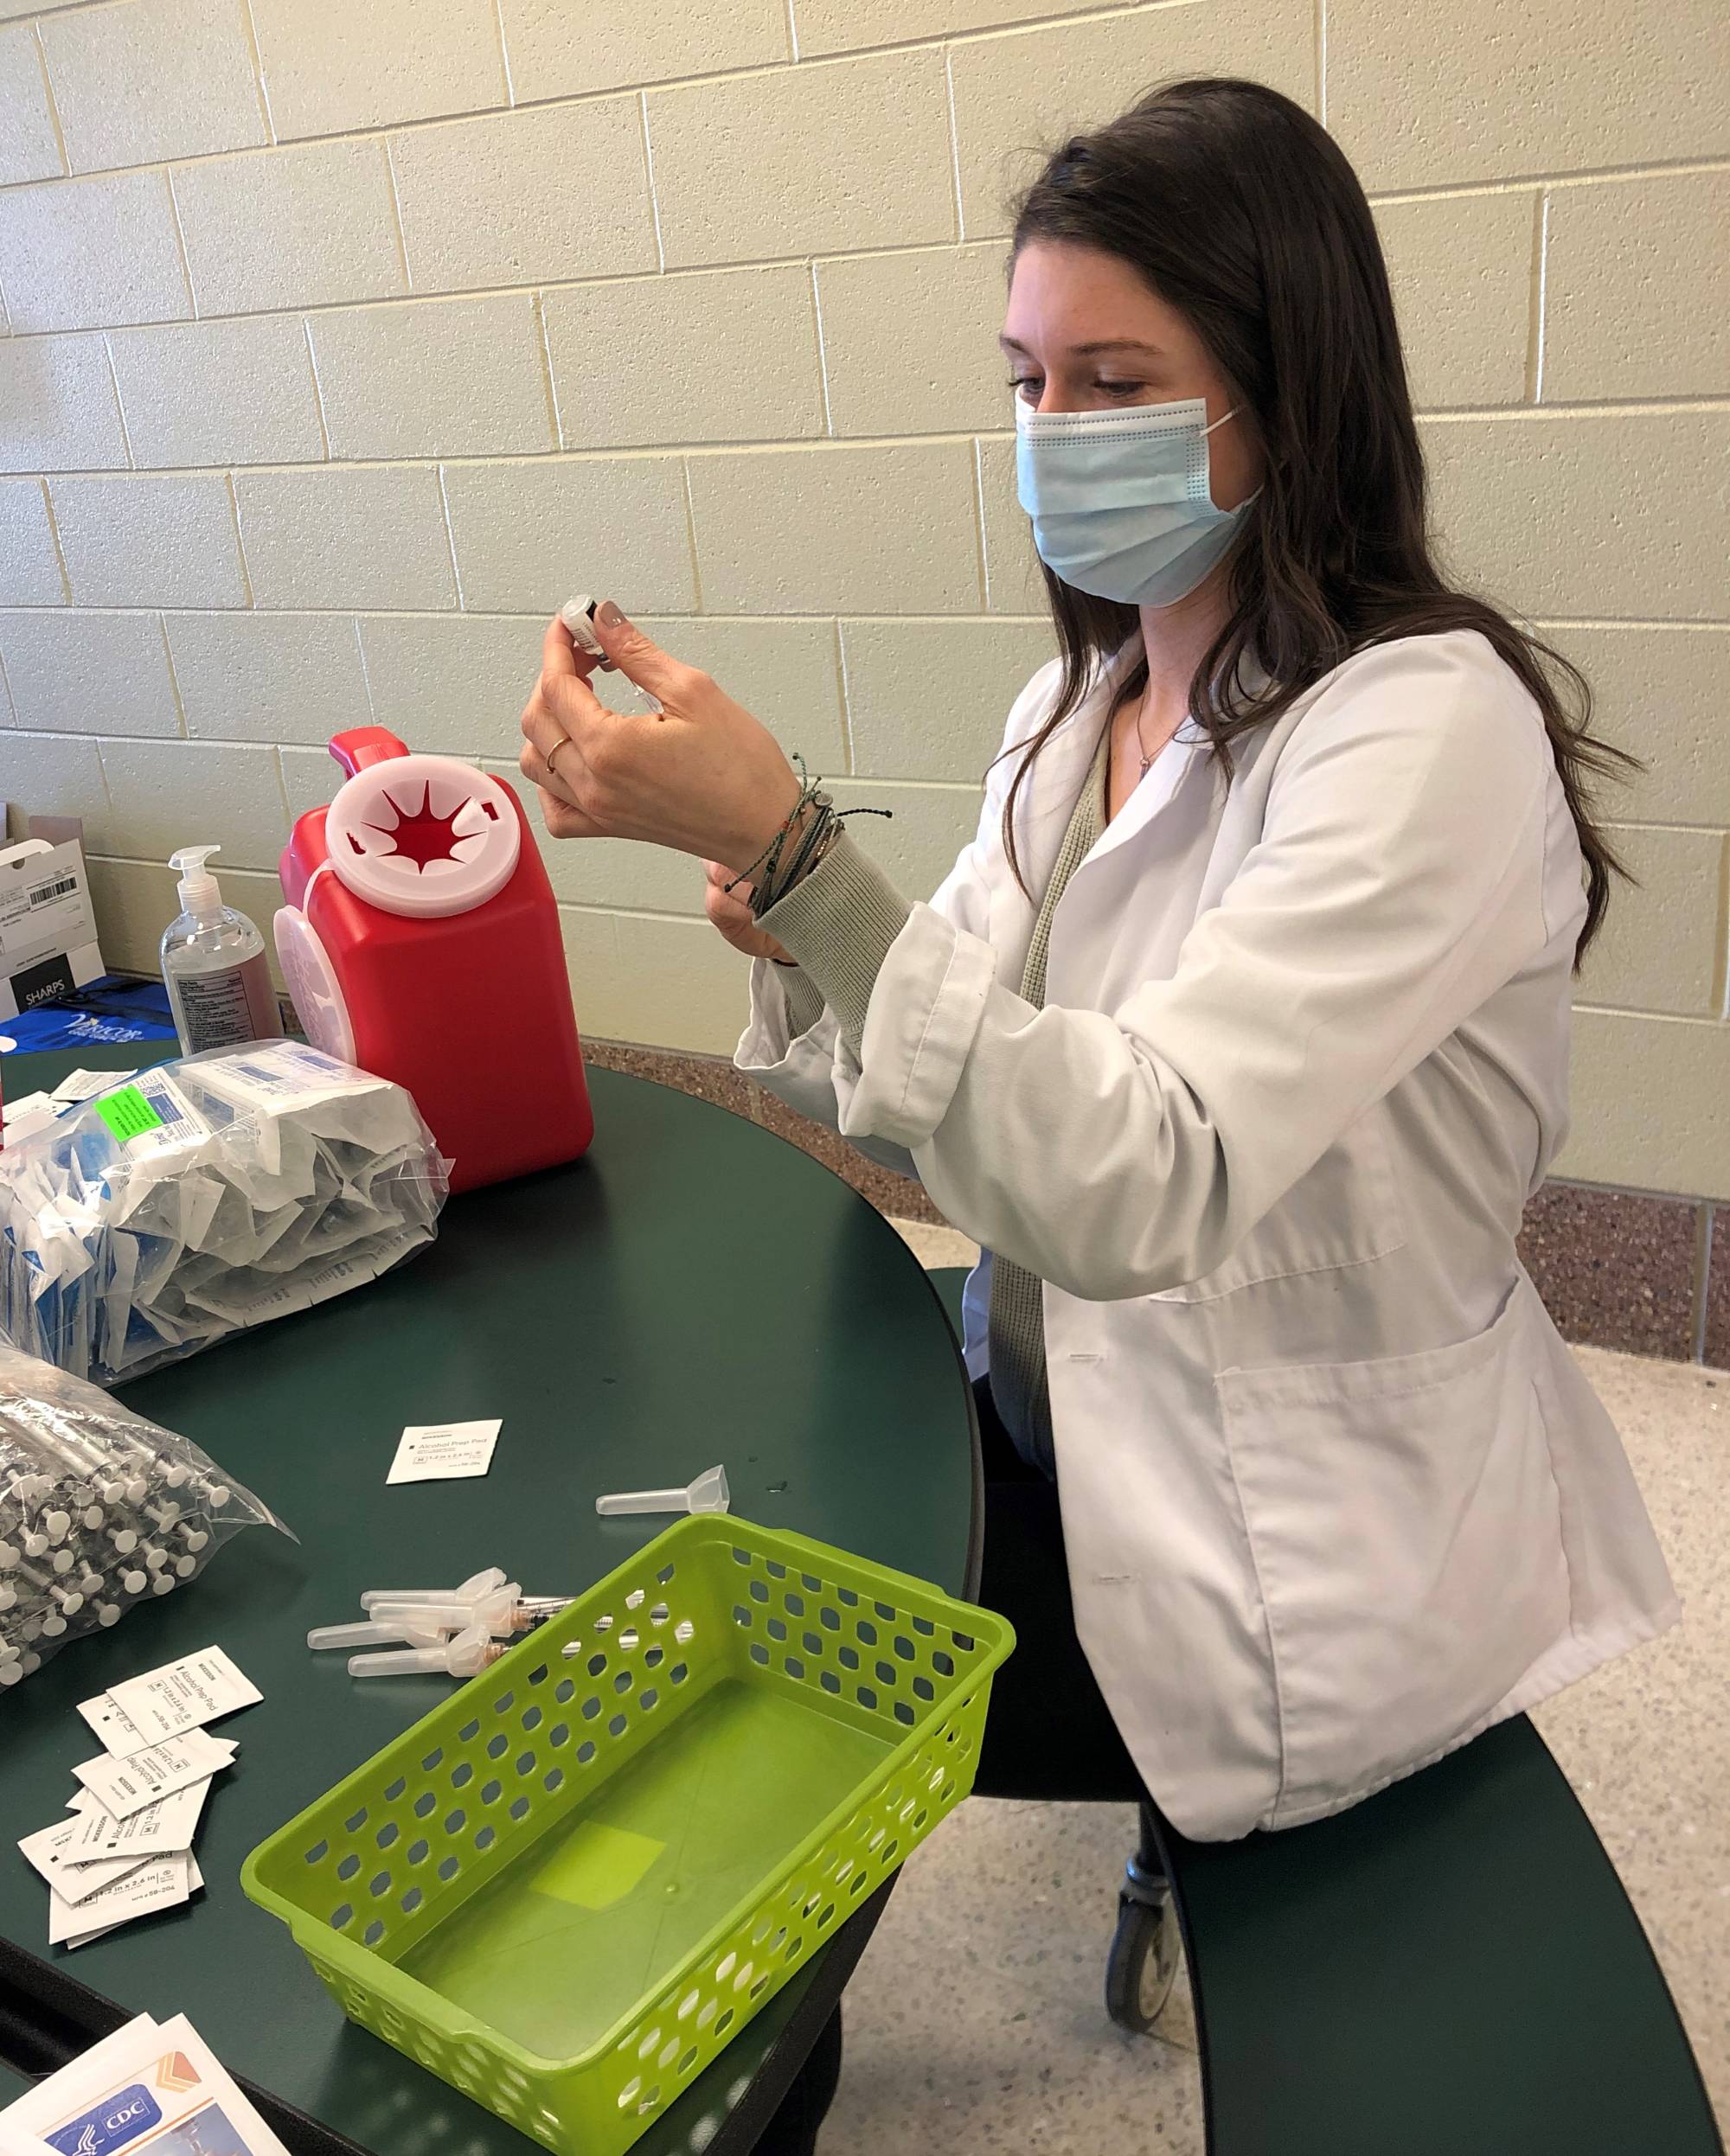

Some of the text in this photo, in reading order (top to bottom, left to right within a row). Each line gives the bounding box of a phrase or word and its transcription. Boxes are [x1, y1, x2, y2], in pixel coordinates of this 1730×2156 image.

[26, 979, 66, 1005] SHARPS
[180, 1670, 201, 1689] Alcohol
[195, 1686, 208, 1699] Prep
[204, 1697, 219, 1711] Pad
[126, 1756, 140, 1769] Prep
[134, 1766, 157, 1785] Alcohol
[149, 1885, 176, 1897] 58-204
[106, 2101, 145, 2130] CDC
